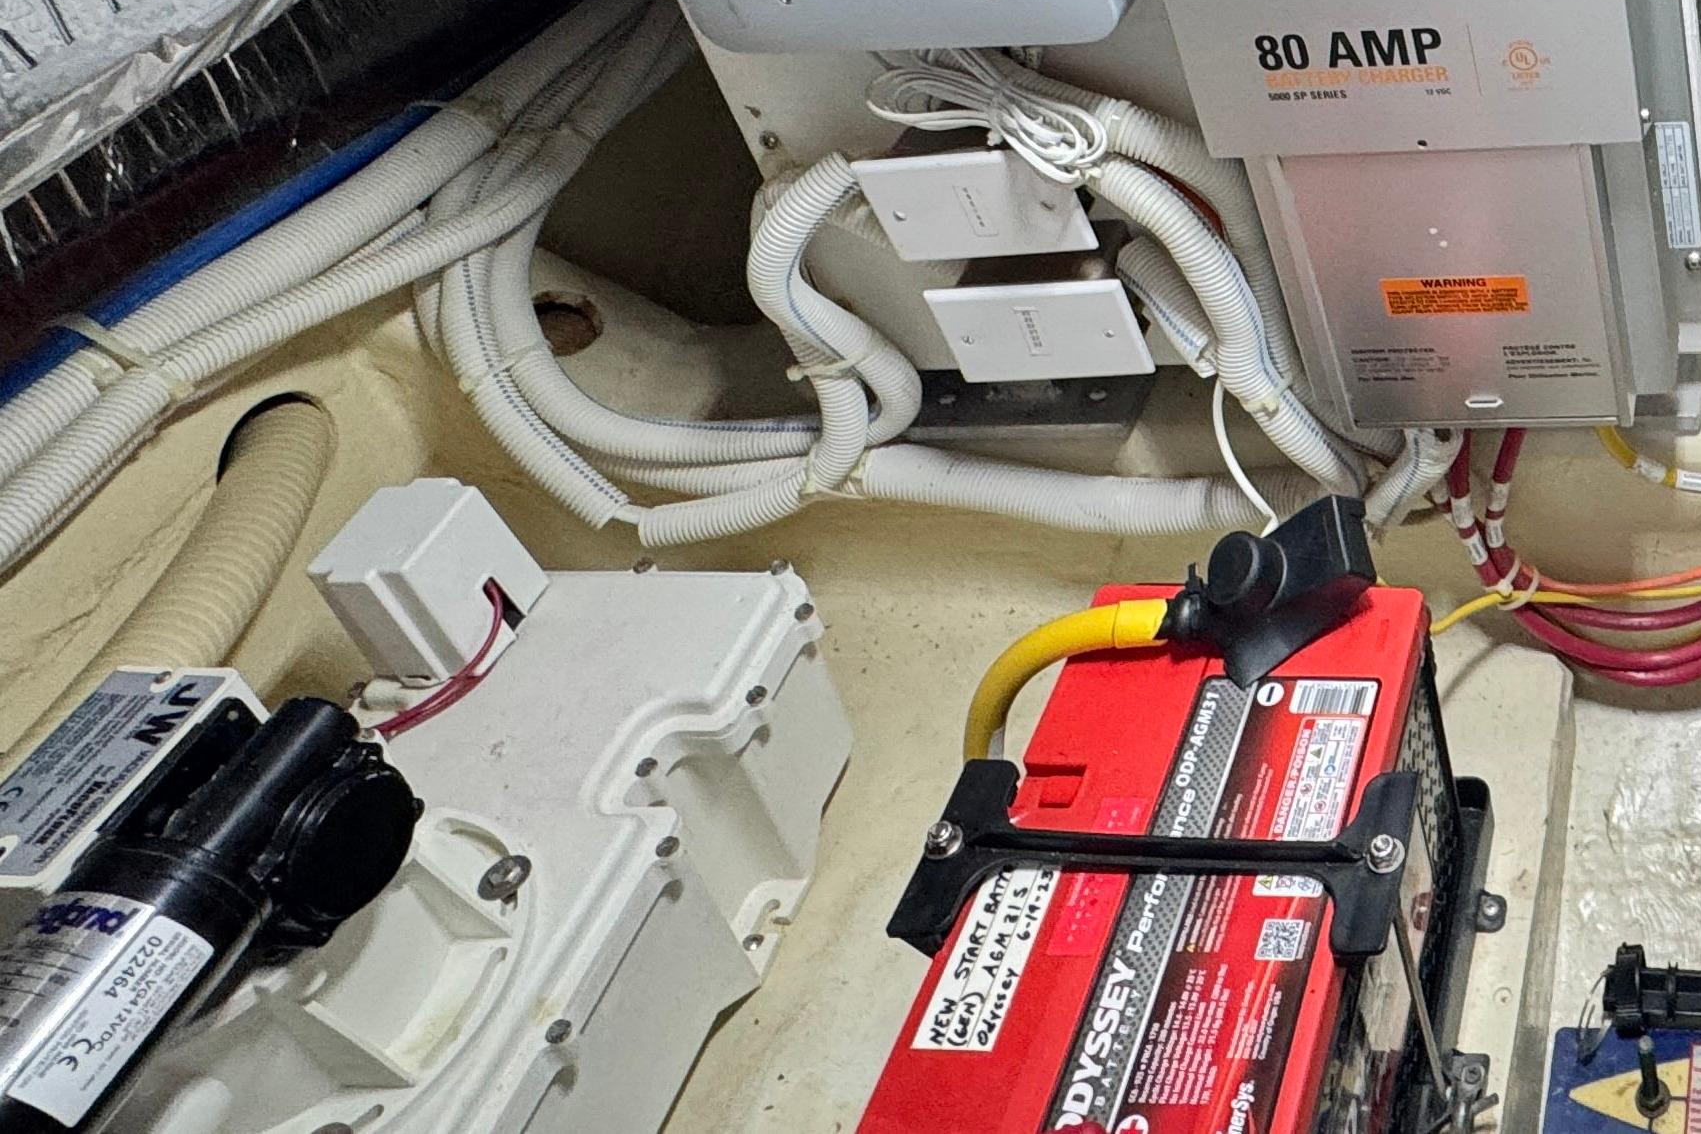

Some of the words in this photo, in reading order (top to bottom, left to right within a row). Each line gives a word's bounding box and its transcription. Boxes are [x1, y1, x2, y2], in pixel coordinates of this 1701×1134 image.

[1254, 34, 1311, 71] 80
[1328, 27, 1443, 68] AMP
[1359, 66, 1449, 85] CHARGER
[1293, 91, 1308, 101] SP
[1310, 90, 1348, 100] SERIES
[1420, 277, 1488, 289] WARNING
[1176, 691, 1220, 788] ODP-AGM31
[103, 935, 164, 999] 022464
[930, 997, 958, 1047] NEW
[955, 920, 988, 981] START
[947, 991, 986, 1047] (GEN)
[983, 932, 1011, 979] AGM
[978, 967, 1020, 1047] Odyssey
[1016, 869, 1056, 942] 6-19-23
[1094, 988, 1142, 1107] BATTERY
